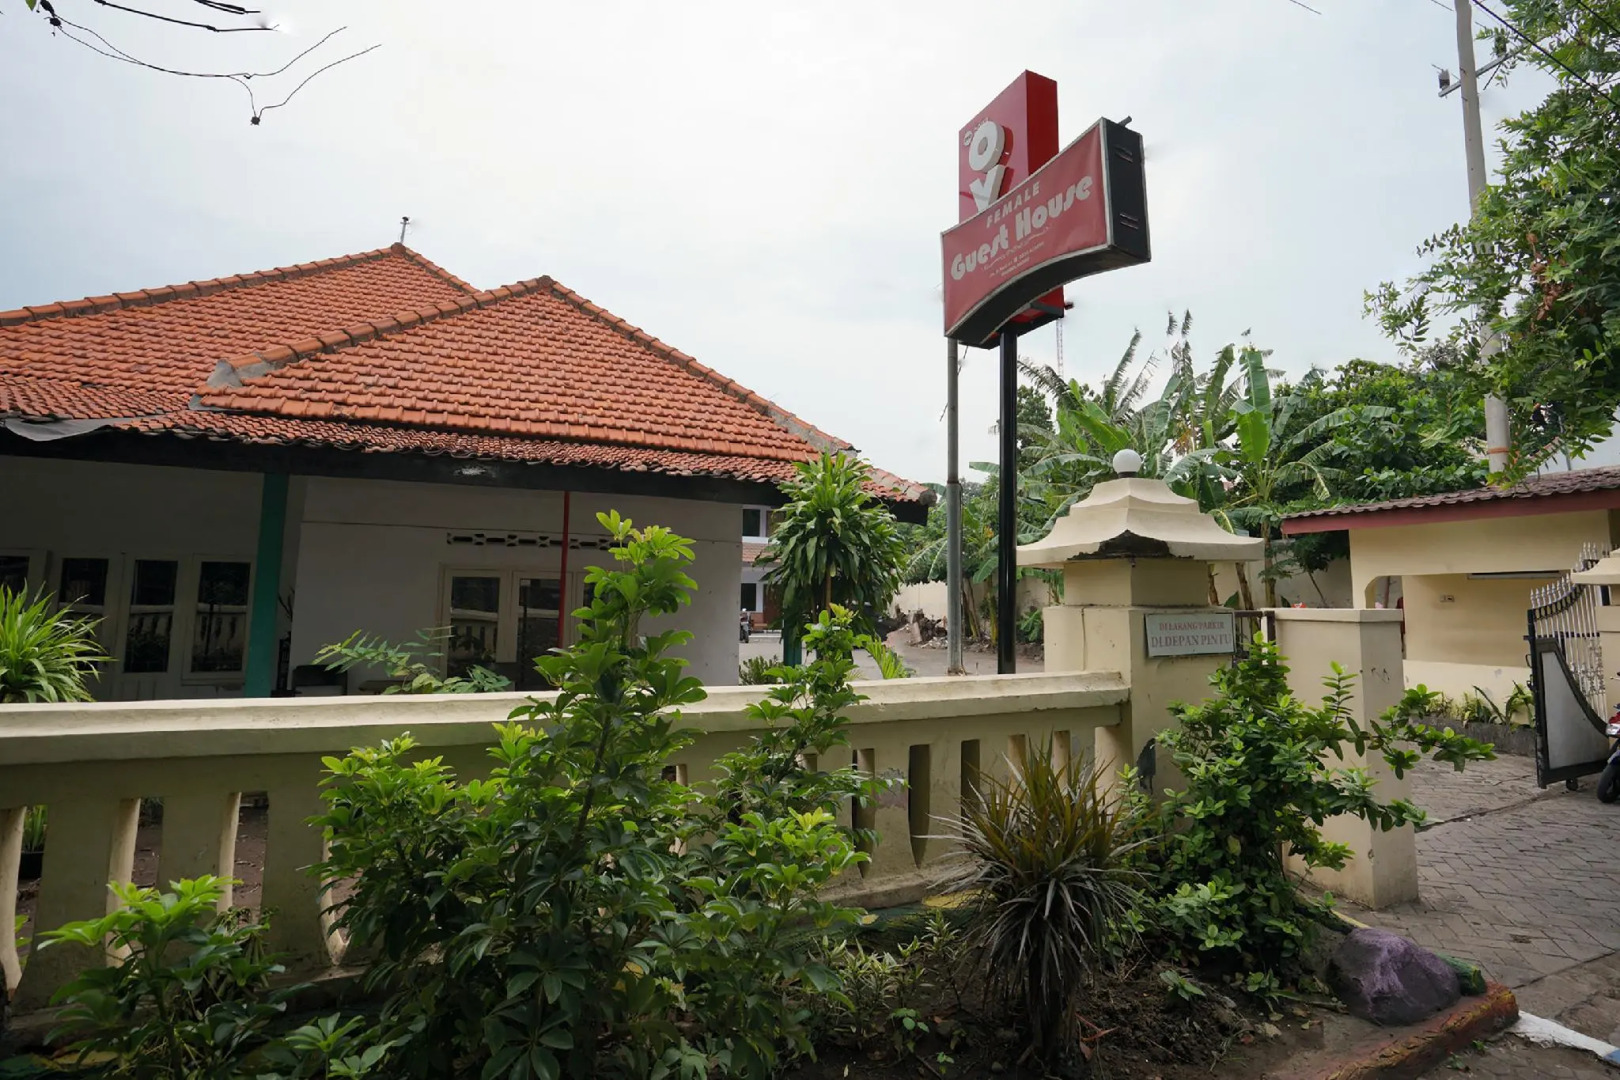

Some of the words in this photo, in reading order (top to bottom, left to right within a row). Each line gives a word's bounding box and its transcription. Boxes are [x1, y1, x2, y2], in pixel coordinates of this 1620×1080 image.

[950, 224, 1009, 280] Guest
[1015, 176, 1093, 241] House
[986, 181, 1040, 229] FEMALE
[1200, 633, 1231, 646] PINTU
